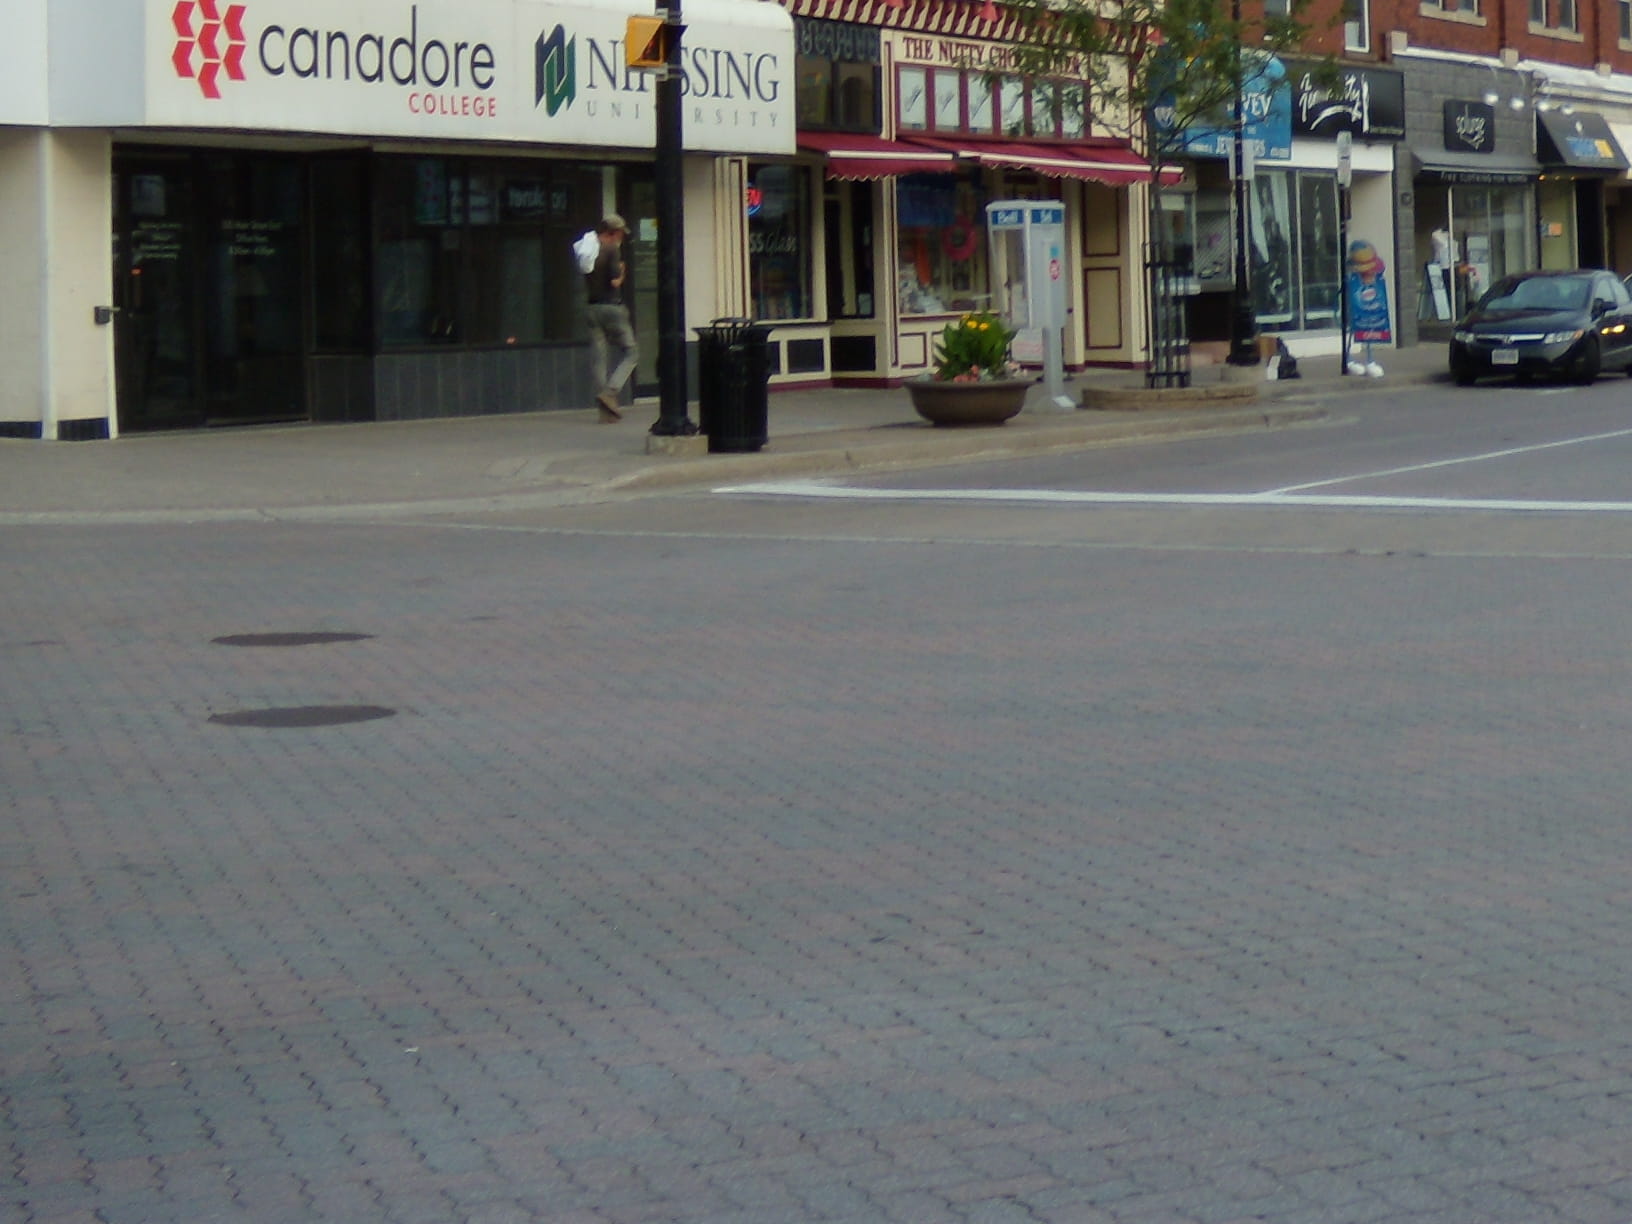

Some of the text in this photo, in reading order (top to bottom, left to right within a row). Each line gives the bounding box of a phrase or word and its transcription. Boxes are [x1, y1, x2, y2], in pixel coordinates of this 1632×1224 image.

[258, 4, 496, 90] canadore
[902, 36, 934, 61] THE
[585, 37, 780, 103] NSSING
[408, 92, 497, 118] COLLEGE
[586, 100, 779, 128] UNIRSITY
